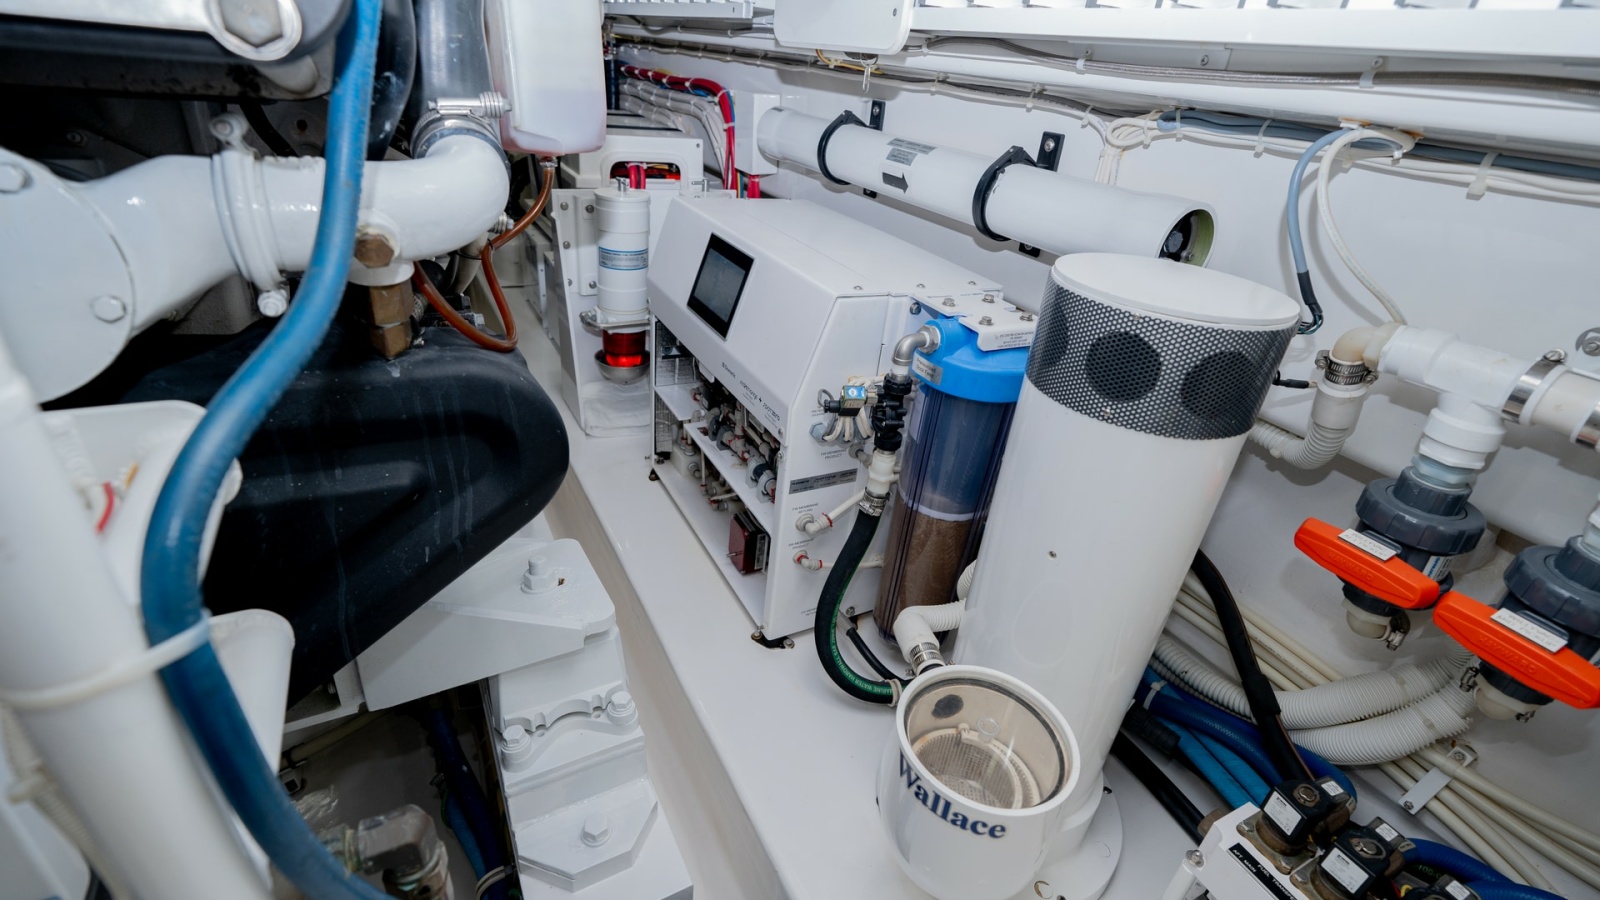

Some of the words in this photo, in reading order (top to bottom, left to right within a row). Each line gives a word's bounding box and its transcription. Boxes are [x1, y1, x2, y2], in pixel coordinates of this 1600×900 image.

[1328, 551, 1373, 581] HAYWARD
[1478, 635, 1538, 674] HAYWARD
[899, 748, 1006, 839] Wallace
